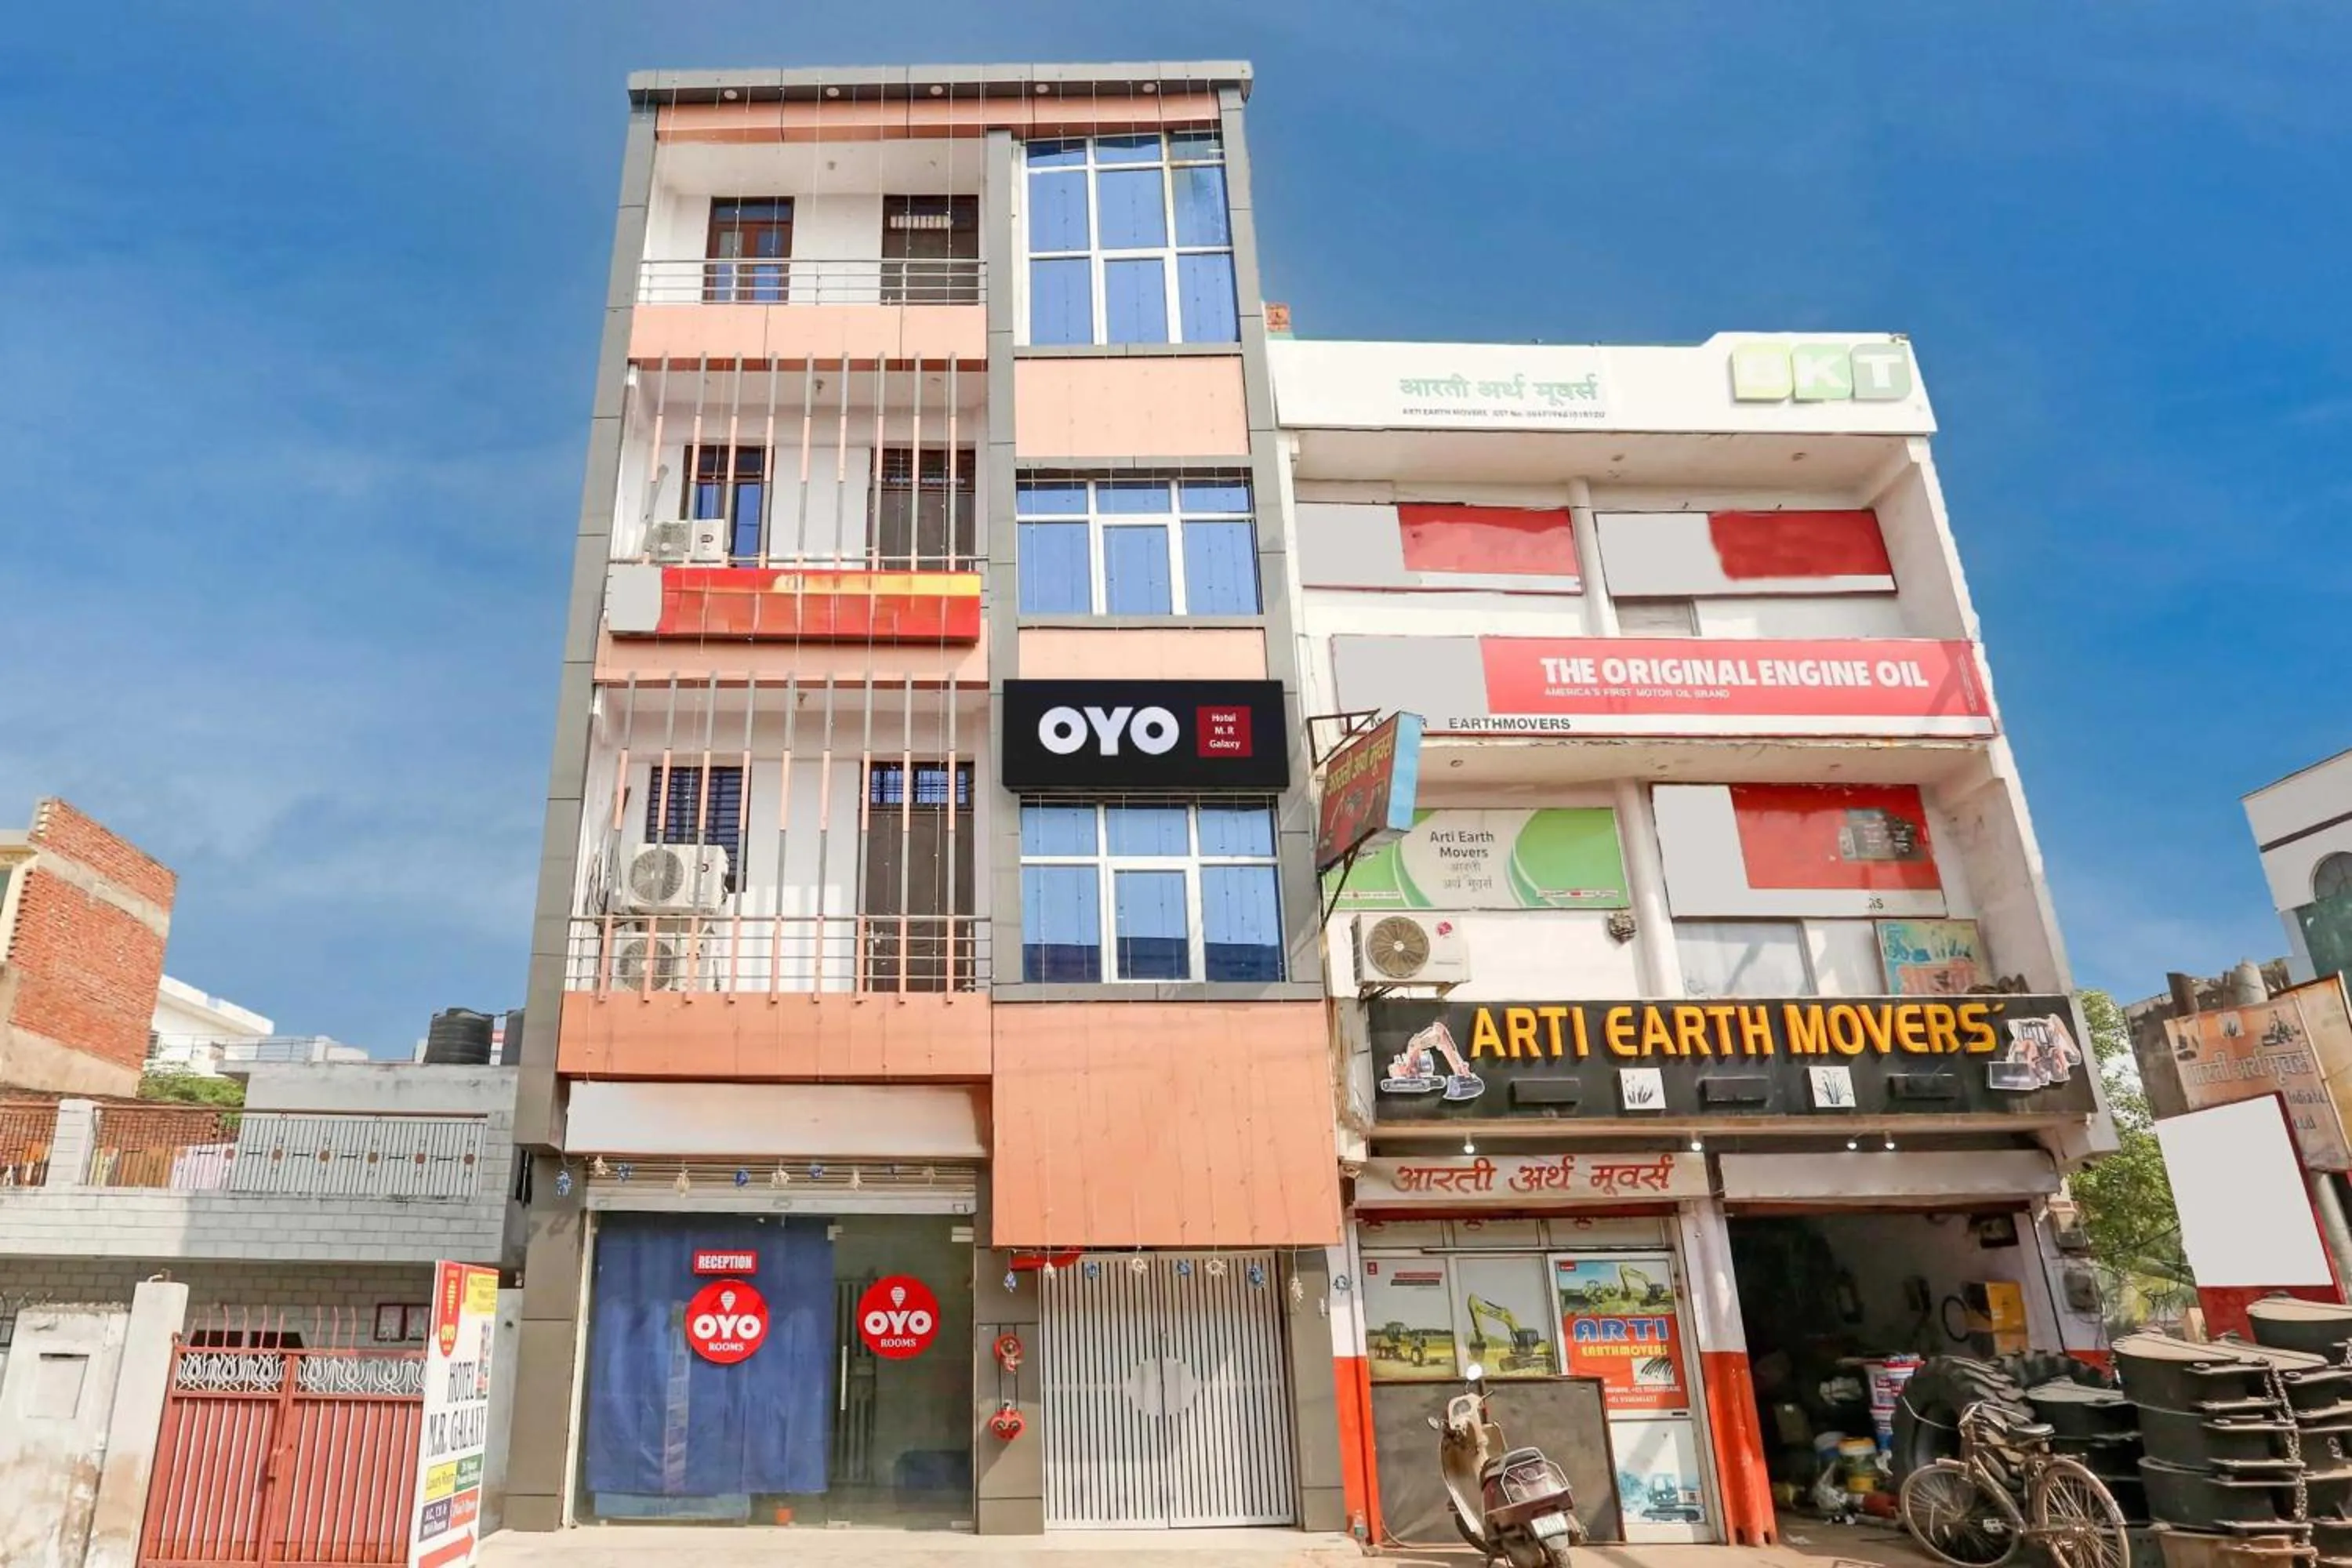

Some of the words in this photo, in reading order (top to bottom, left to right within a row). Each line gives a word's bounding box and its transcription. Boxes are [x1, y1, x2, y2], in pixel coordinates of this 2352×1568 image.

[1540, 657, 1597, 684] THE
[1601, 657, 1759, 687] ORIGINAL
[1761, 659, 1871, 687] ENGINE
[1875, 660, 1929, 688] OIL
[1544, 688, 1601, 697] AMERICA'S
[1604, 688, 1632, 697] FIRST
[1636, 688, 1673, 698] MOTOR
[1676, 689, 1692, 699] OIL
[1694, 690, 1730, 699] BRAND
[1449, 717, 1571, 730] EARTHMOVERS
[1037, 706, 1180, 756] OYO
[1209, 739, 1240, 750] Galaxy
[1430, 831, 1454, 843] Arti
[1459, 831, 1494, 843] Earth
[1439, 848, 1489, 859] Movers
[1470, 1006, 1589, 1058] ARTI
[1605, 1005, 1774, 1056] EARTH
[1782, 1003, 2001, 1055] MOVERS
[1391, 1157, 1497, 1192] आरती
[1509, 1155, 1575, 1192] अर्थ
[1590, 1153, 1674, 1195] मूवर्स
[698, 1255, 753, 1269] RECEPTION
[693, 1314, 761, 1340] OYO
[864, 1310, 932, 1335] OYO
[1573, 1318, 1668, 1342] ARTI
[708, 1341, 744, 1352] ROOMS
[880, 1338, 916, 1348] ROOMS
[1581, 1345, 1668, 1357] EARTHMOVERS
